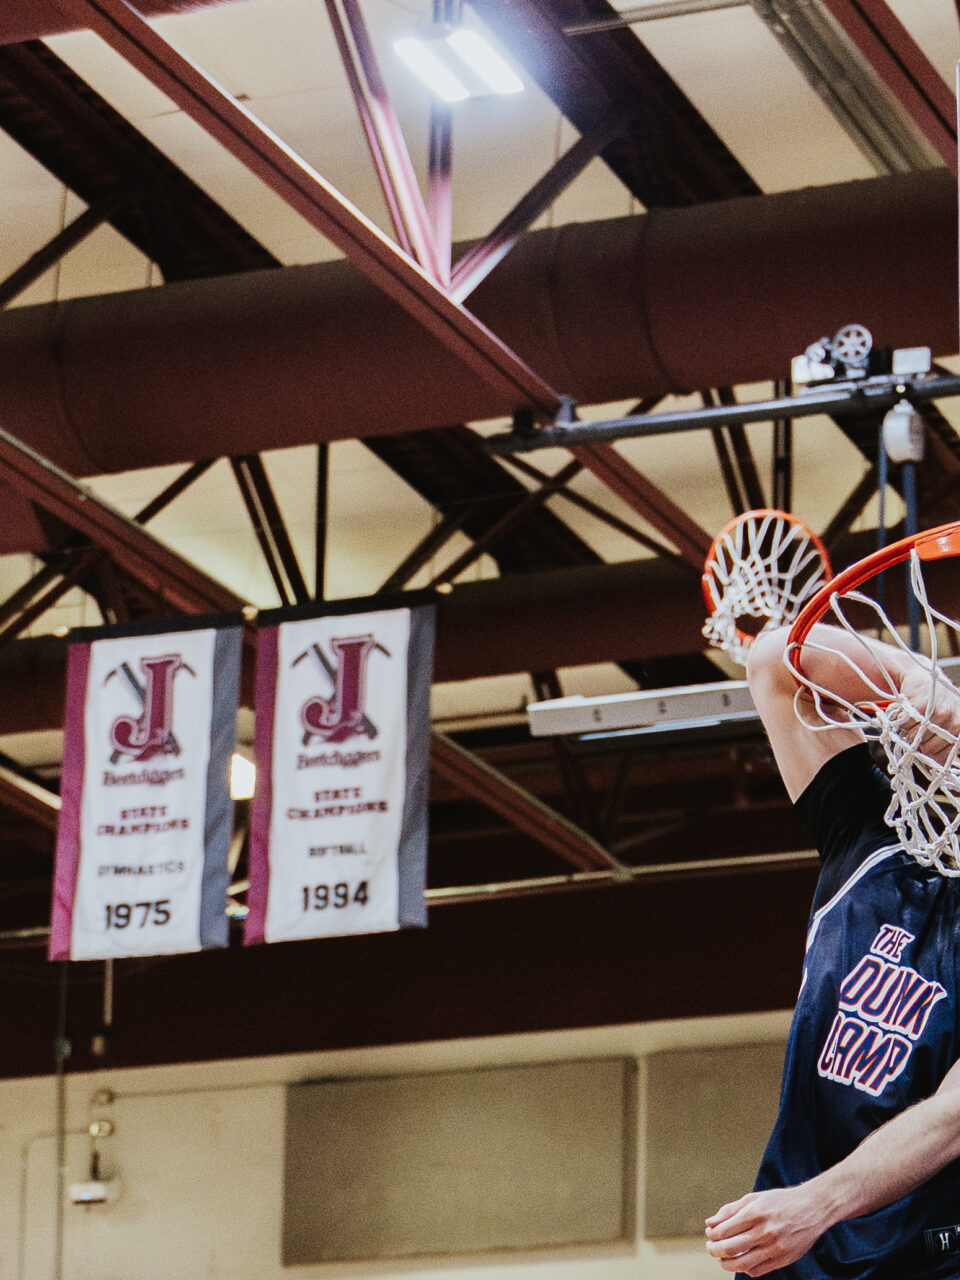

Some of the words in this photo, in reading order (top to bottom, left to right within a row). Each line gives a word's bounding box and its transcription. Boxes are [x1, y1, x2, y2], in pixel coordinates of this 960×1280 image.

[287, 801, 388, 819] CHAMPIONS
[314, 787, 361, 802] STATE
[97, 818, 190, 836] CHAMPIONS
[121, 805, 168, 820] STATE
[302, 880, 369, 911] 1994
[105, 899, 170, 930] 1975
[870, 924, 915, 963] THE
[838, 955, 948, 1041] DUNK
[817, 1011, 913, 1097] CAMP
